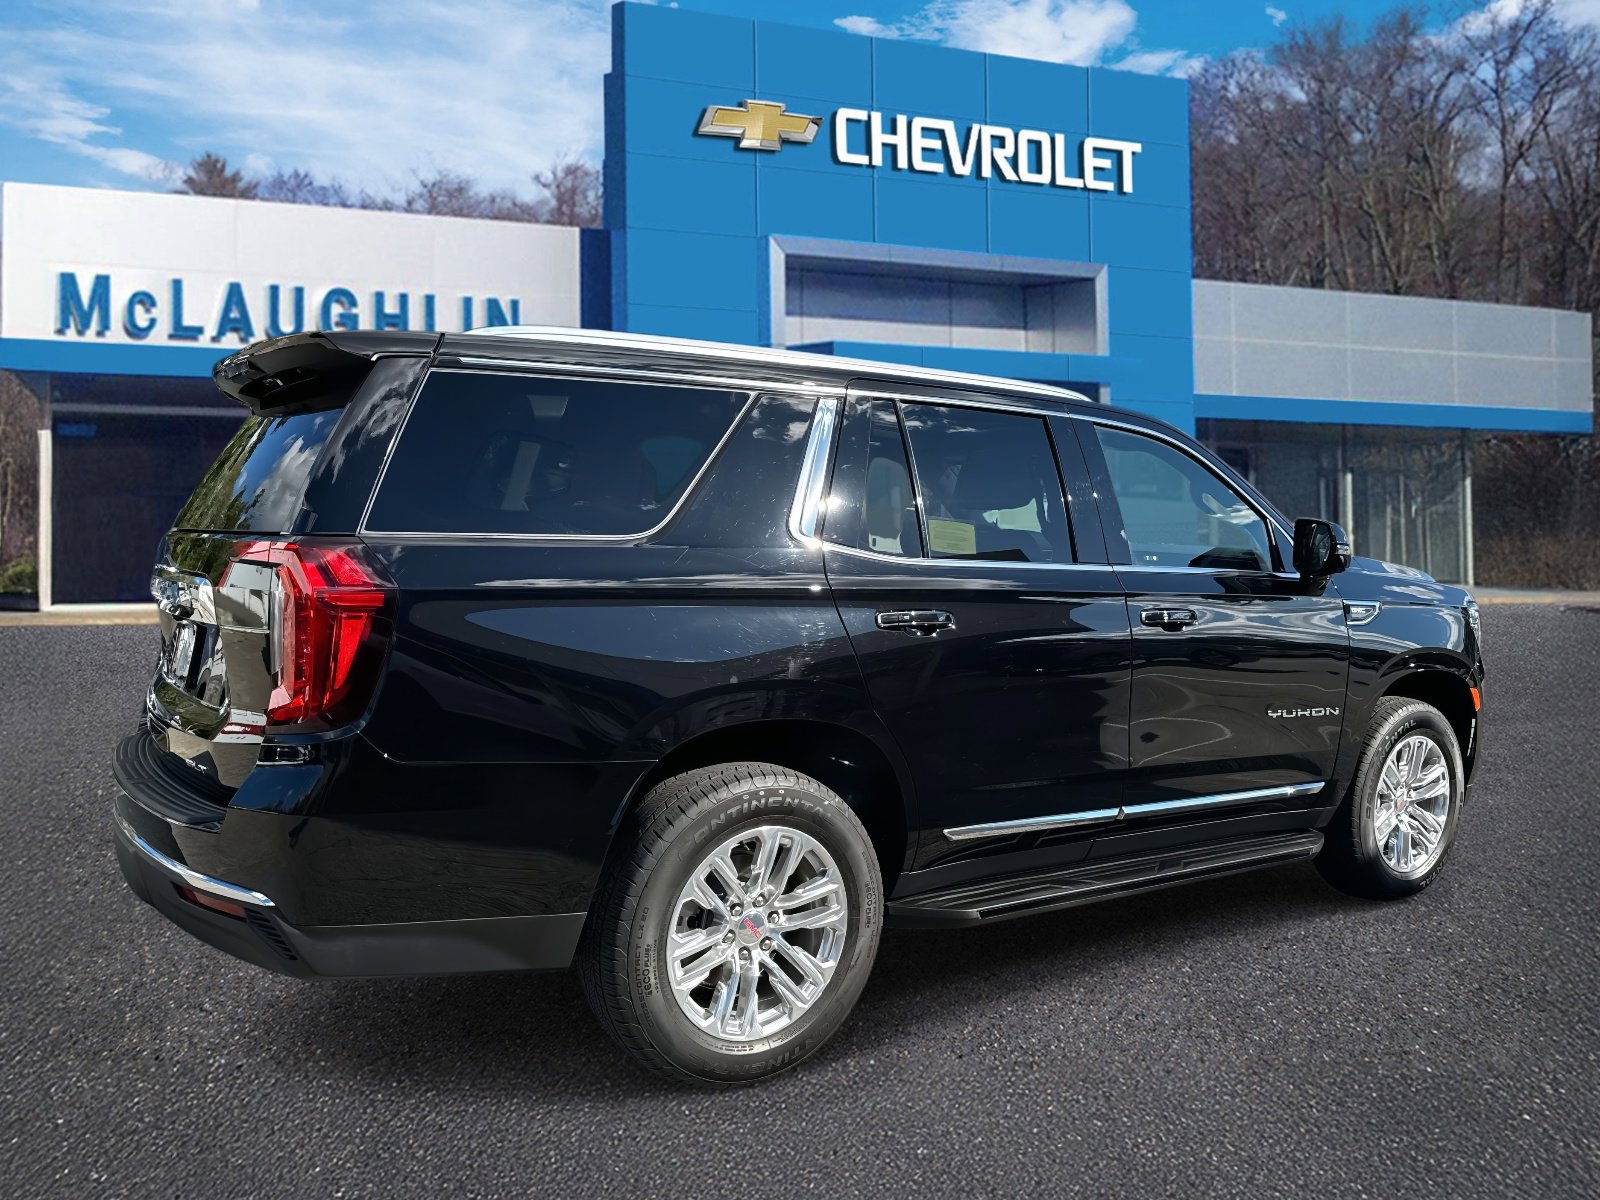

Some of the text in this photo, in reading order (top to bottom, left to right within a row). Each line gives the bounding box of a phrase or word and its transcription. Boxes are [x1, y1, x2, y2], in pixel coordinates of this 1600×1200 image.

[835, 107, 1142, 193] CHEVROLET
[1267, 707, 1340, 719] YUKON
[686, 796, 831, 853] ONTINENTA
[743, 917, 762, 939] GMC
